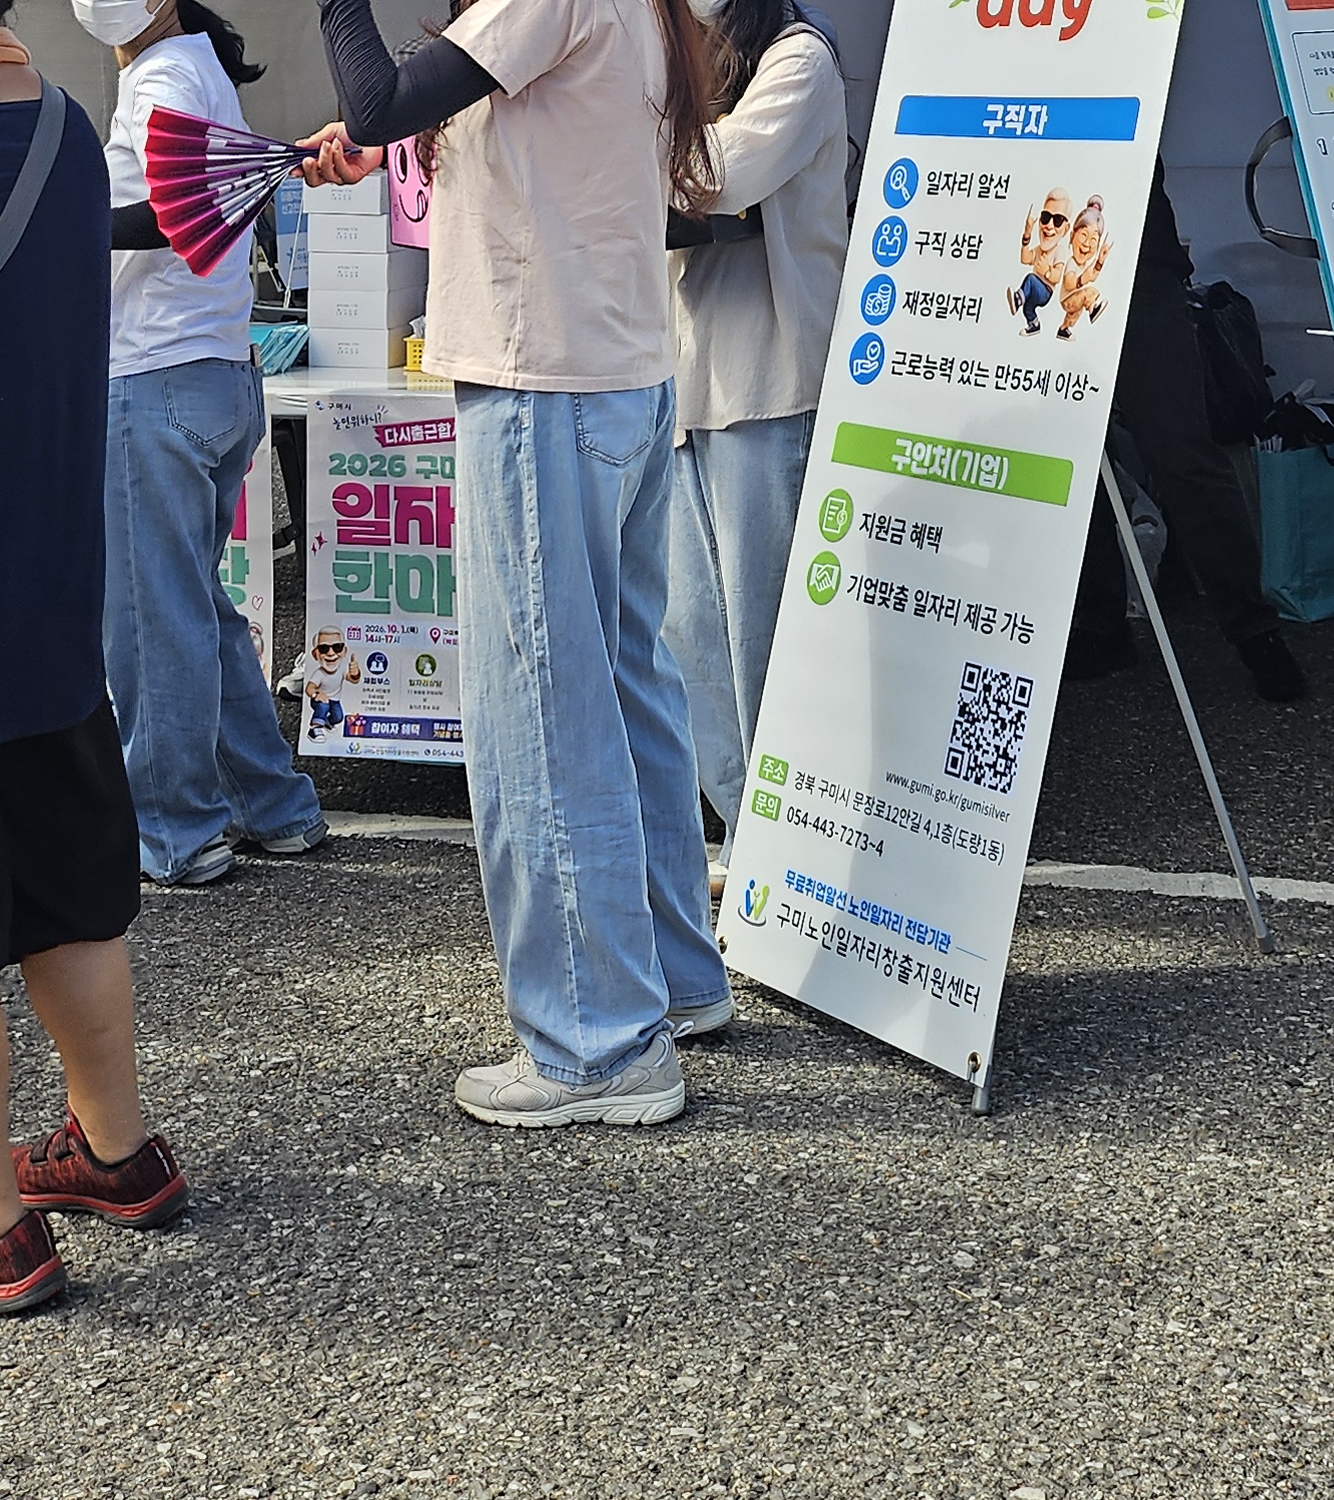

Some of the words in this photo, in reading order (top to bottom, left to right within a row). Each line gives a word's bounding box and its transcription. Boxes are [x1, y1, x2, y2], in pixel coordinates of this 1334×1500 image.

[982, 103, 1049, 136] 구직자
[926, 171, 973, 197] 일자리
[977, 173, 1011, 200] 알선
[914, 230, 946, 258] 구직
[951, 232, 983, 260] 상담
[901, 290, 983, 323] 재정일자리
[890, 350, 954, 384] 근로능력
[957, 360, 990, 389] 있는
[994, 364, 1050, 397] 만55세
[1054, 371, 1100, 401] 이상~
[328, 452, 407, 478] 2026
[890, 438, 1009, 490] 구인처(기업)
[859, 511, 906, 546] 지원금
[909, 522, 943, 554] 혜택
[846, 574, 909, 613] 기업맞춤
[912, 590, 962, 627] 일자리
[963, 602, 997, 636] 제공
[1000, 611, 1035, 645] 가능
[761, 757, 786, 783] 주소
[754, 791, 780, 820] 문의
[793, 771, 816, 794] 경북
[817, 778, 851, 808] 구미시
[852, 790, 923, 835] 문장로12안길
[885, 769, 1011, 823] www.gumi.go.kr/gumisilver
[786, 805, 885, 858] 054-443-7273~4
[784, 869, 848, 912] 무료취업알선
[847, 894, 903, 936] 노인일자리
[904, 916, 952, 955] 전담기관
[775, 902, 981, 1014] 구미노인일자리창출지원센터
